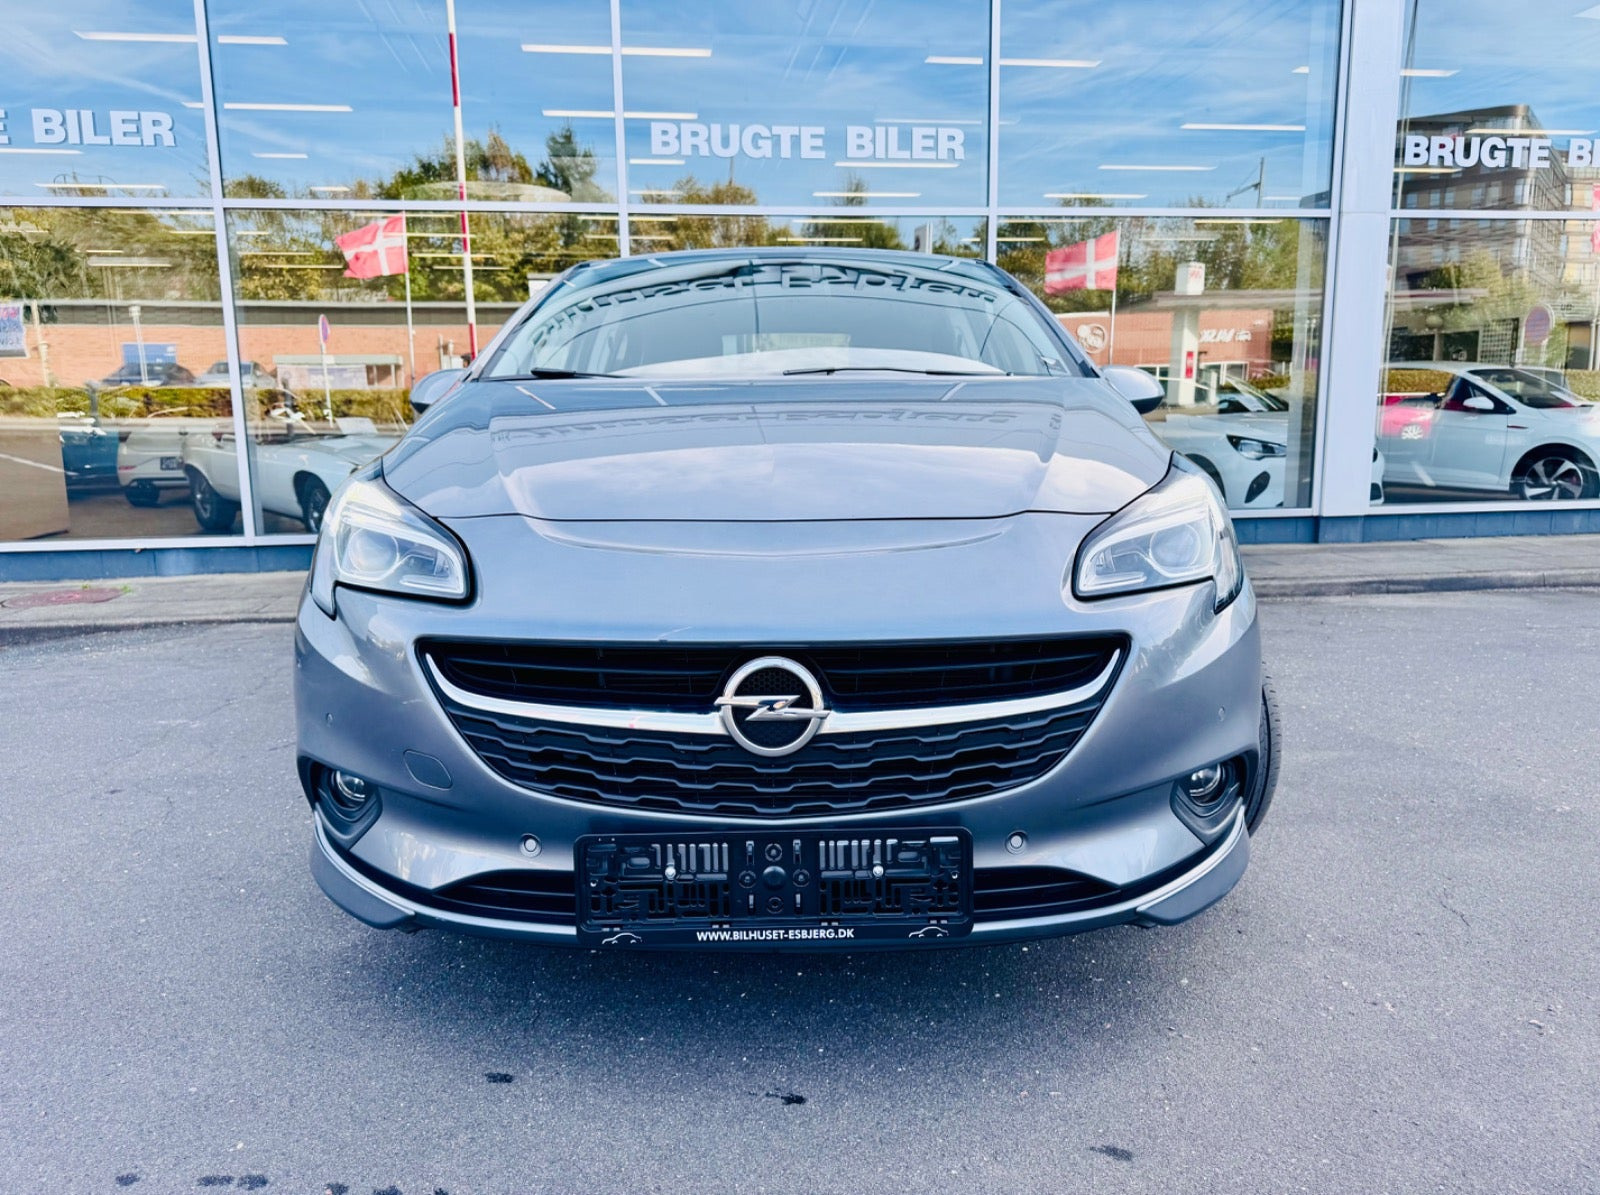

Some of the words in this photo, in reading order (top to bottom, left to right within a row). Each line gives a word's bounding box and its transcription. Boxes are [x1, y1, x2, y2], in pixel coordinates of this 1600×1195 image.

[31, 108, 177, 147] BILER
[650, 121, 825, 159] BRUGTE
[846, 125, 965, 161] BILER
[1404, 135, 1552, 168] BRUGTE
[696, 928, 855, 942] WWW.BILHUSET-ESBJERG.DK
